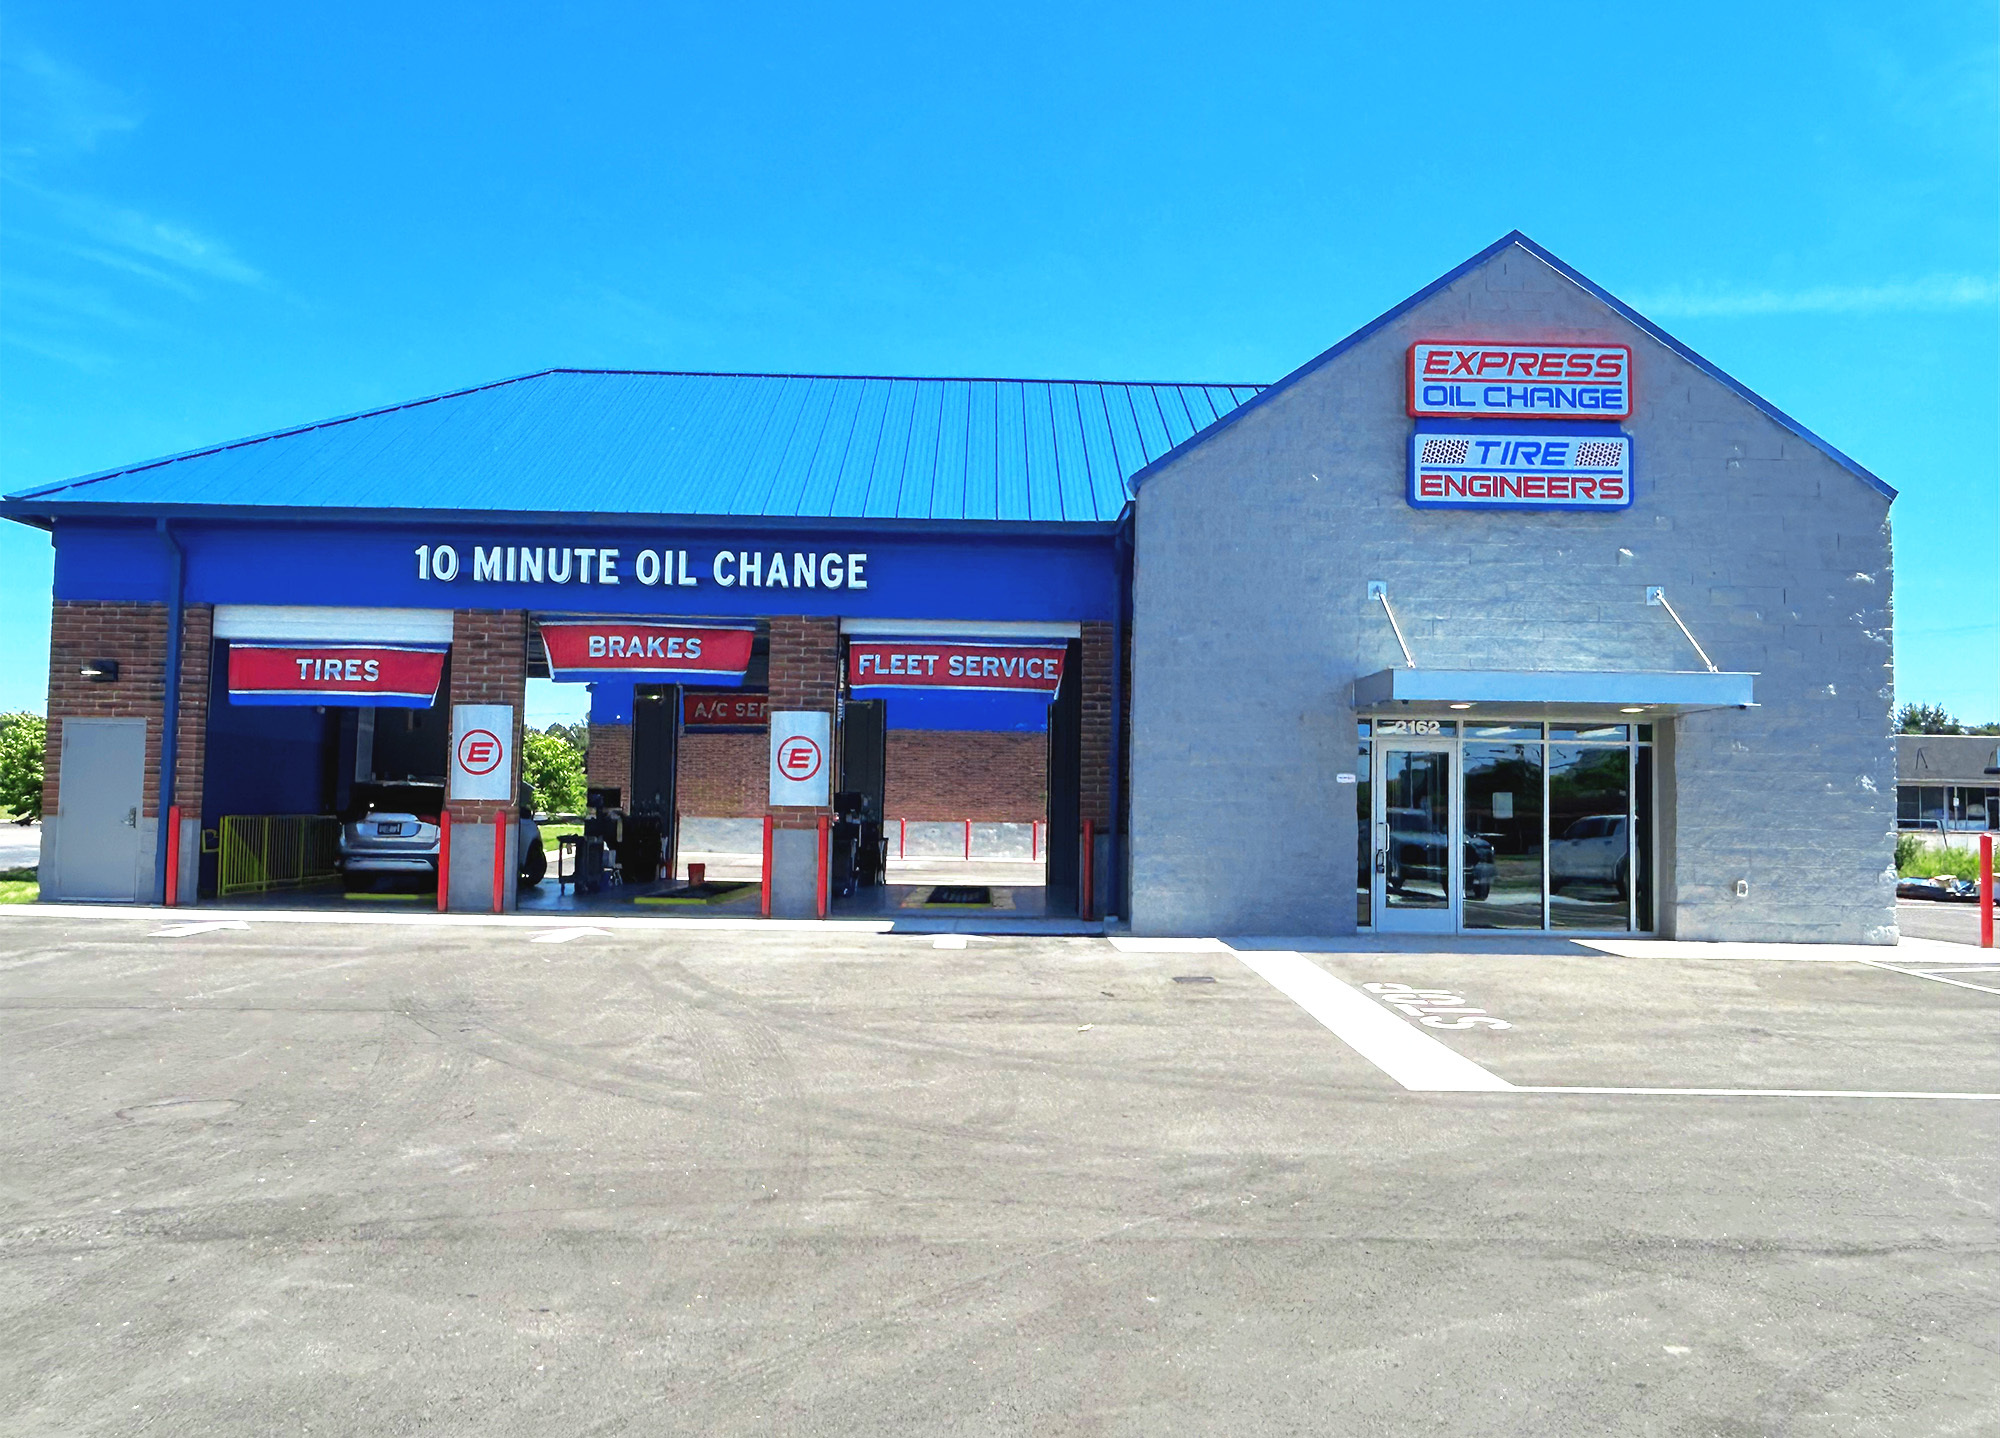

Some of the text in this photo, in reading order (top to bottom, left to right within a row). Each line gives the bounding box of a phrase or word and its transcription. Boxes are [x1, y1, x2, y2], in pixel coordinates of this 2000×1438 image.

[1423, 351, 1624, 378] EXPRESS
[1423, 385, 1623, 409] OIL CHANGE
[1475, 441, 1570, 466] TIRE
[1420, 474, 1624, 499] ENGINEERS
[415, 545, 868, 589] 10 MINUTE OIL CHANGE
[588, 635, 702, 659] BRAKES
[296, 658, 380, 682] TIRES
[858, 654, 1059, 680] FLEET SERVICE
[695, 701, 729, 718] A/C
[1395, 720, 1440, 736] 2162
[467, 742, 494, 762] E
[787, 748, 813, 768] E
[1362, 982, 1512, 1030] STOP
